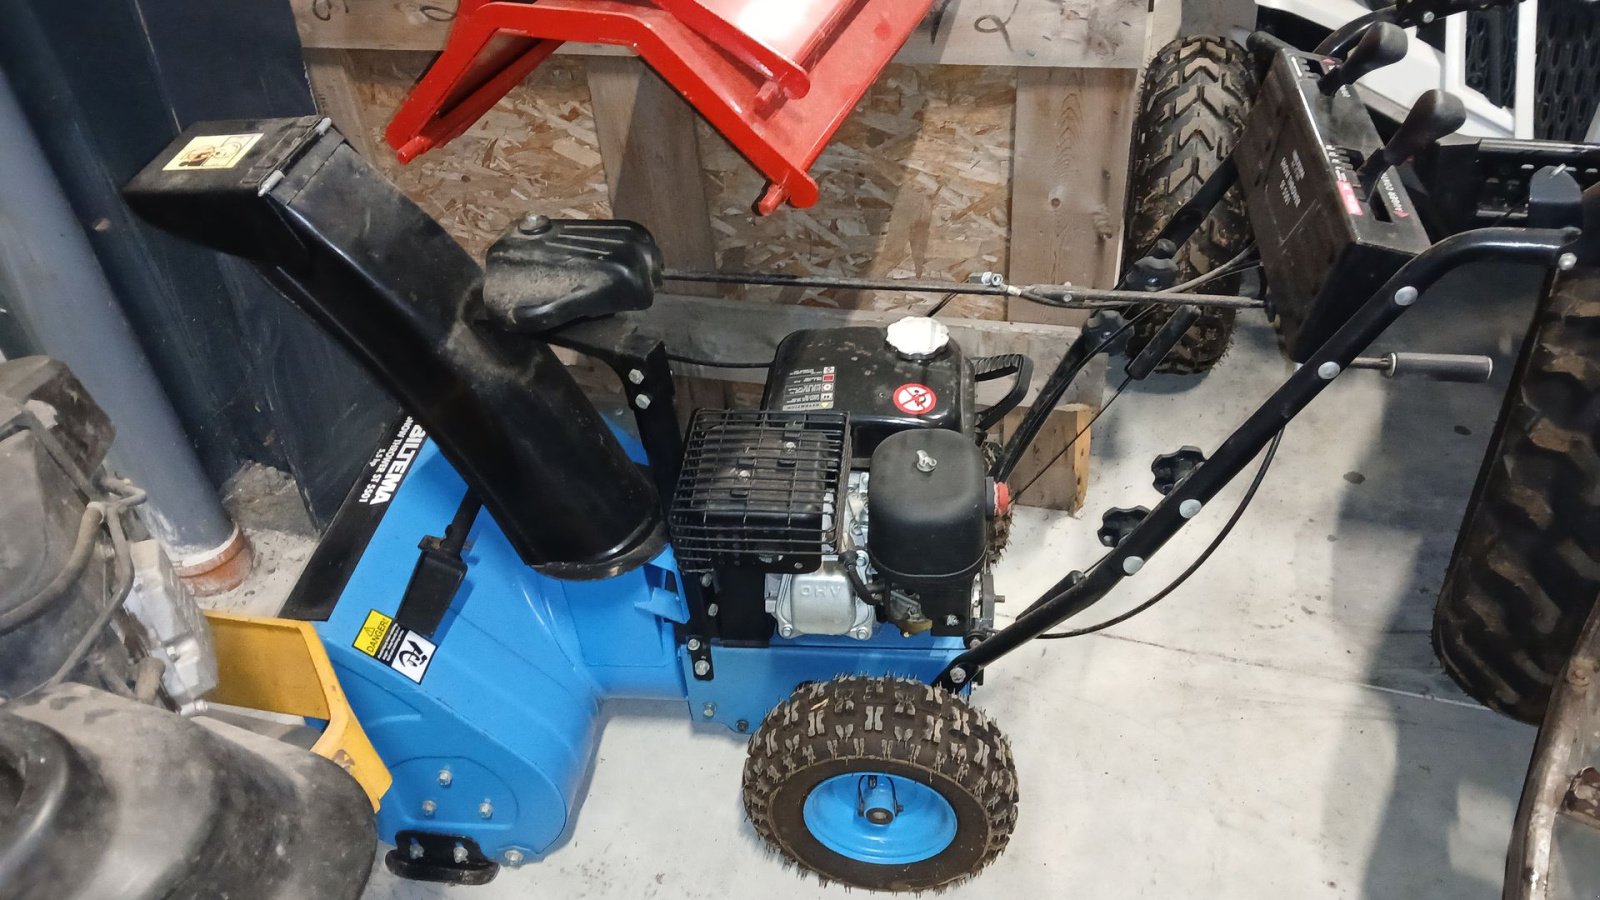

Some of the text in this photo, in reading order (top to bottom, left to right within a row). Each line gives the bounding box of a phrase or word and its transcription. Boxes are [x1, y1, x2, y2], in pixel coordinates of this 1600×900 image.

[369, 424, 426, 505] BILTEMA
[376, 438, 402, 473] THROWER
[370, 473, 382, 483] ST
[358, 483, 376, 503] 5501
[800, 584, 841, 599] OHV
[366, 617, 389, 653] DANGER!
